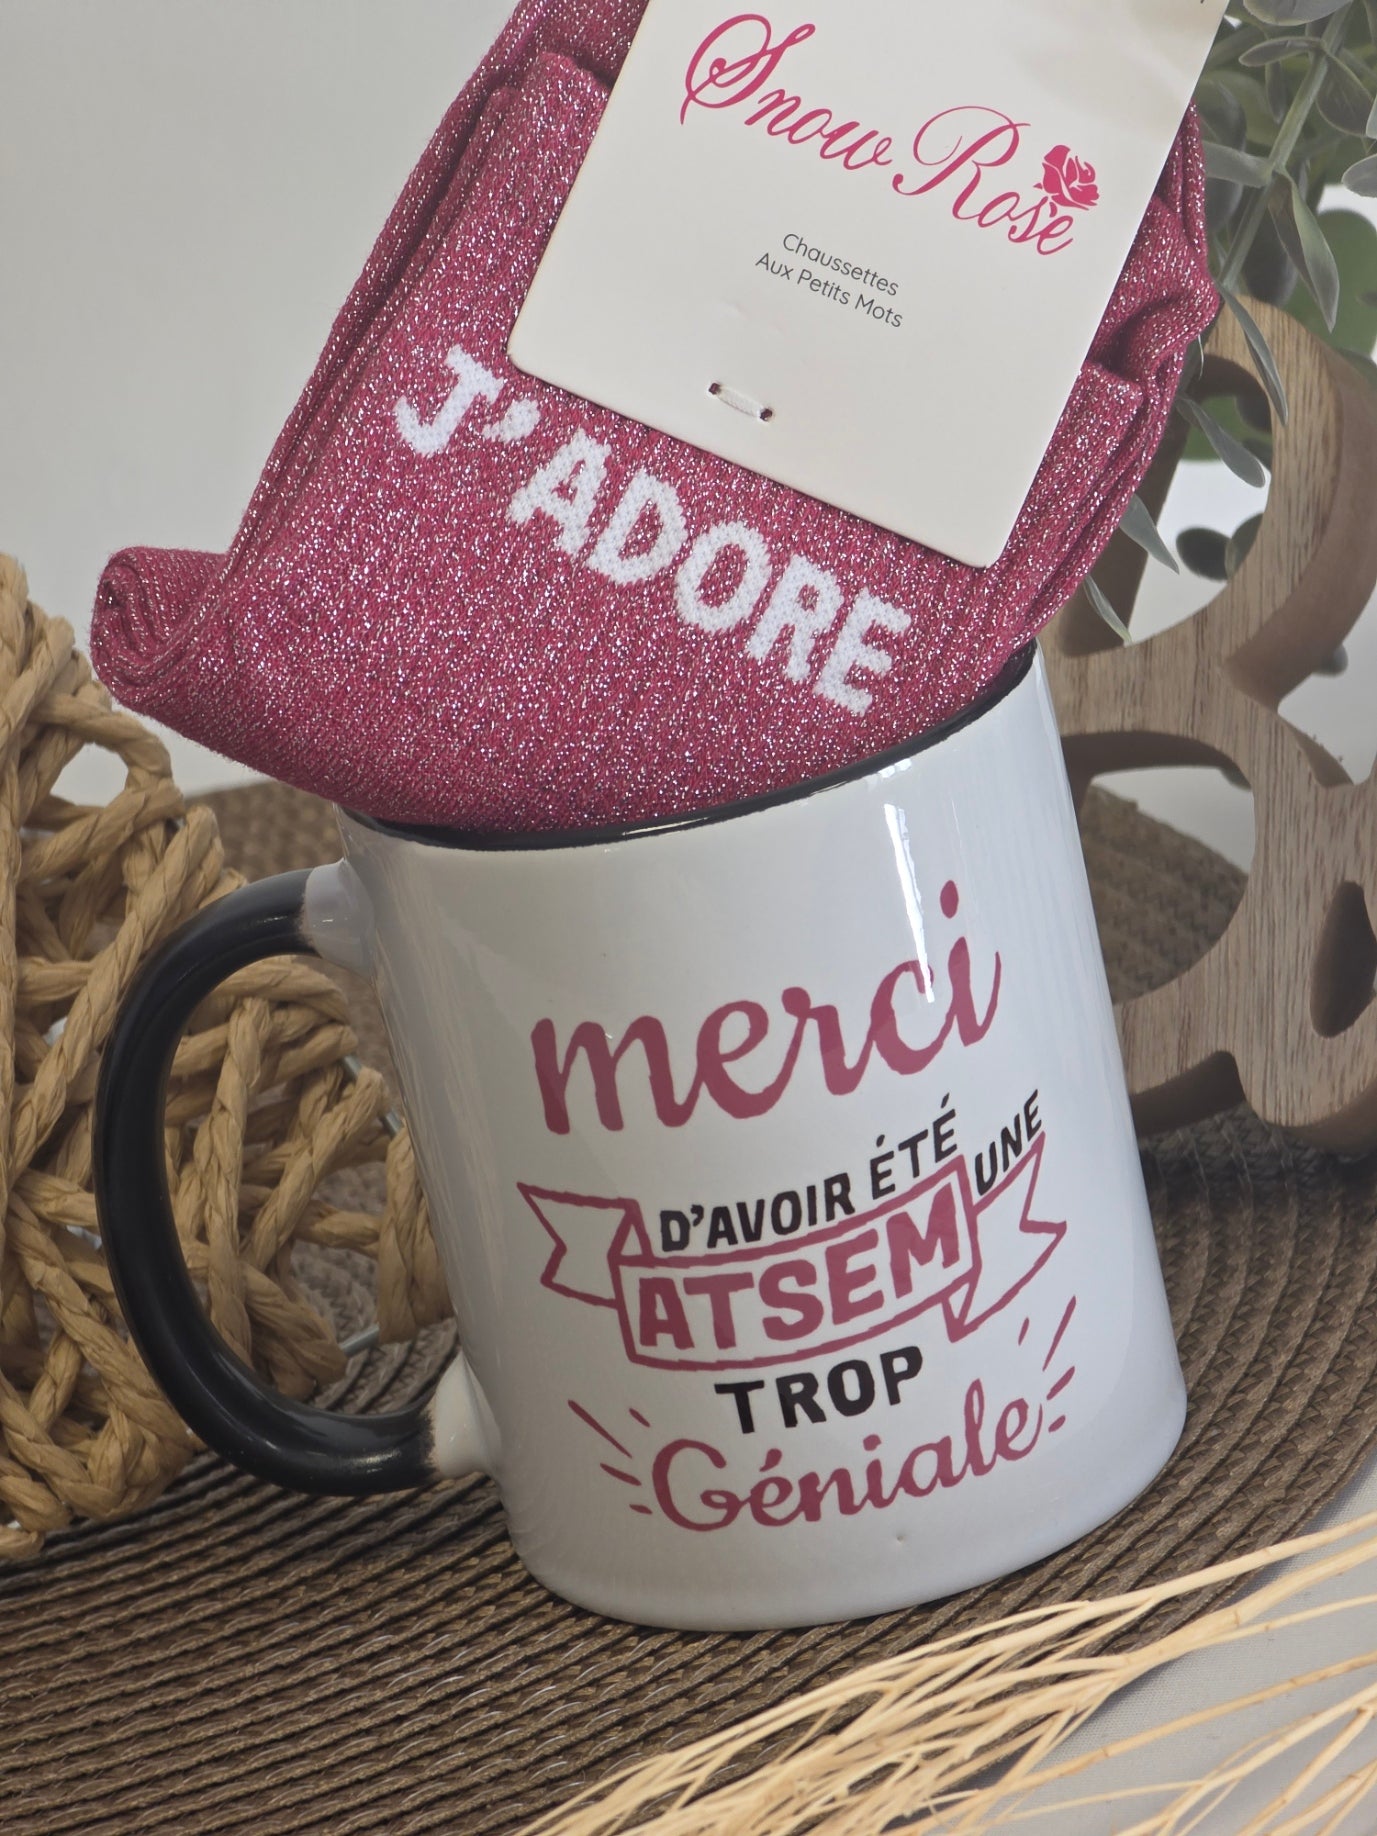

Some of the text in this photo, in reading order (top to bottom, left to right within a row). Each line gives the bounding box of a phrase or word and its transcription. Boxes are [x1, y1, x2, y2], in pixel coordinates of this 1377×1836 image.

[680, 14, 1075, 255] Snow Rose
[755, 252, 903, 328] Aux Petits Mots
[782, 233, 899, 297] Chaussettes
[530, 880, 1001, 1135] merci
[659, 1089, 1043, 1252] D'AVOIR ÉTÉ UNE
[638, 1182, 960, 1349] ATSEM
[652, 1378, 1043, 1532] Géniale
[714, 1345, 924, 1434] TROP
